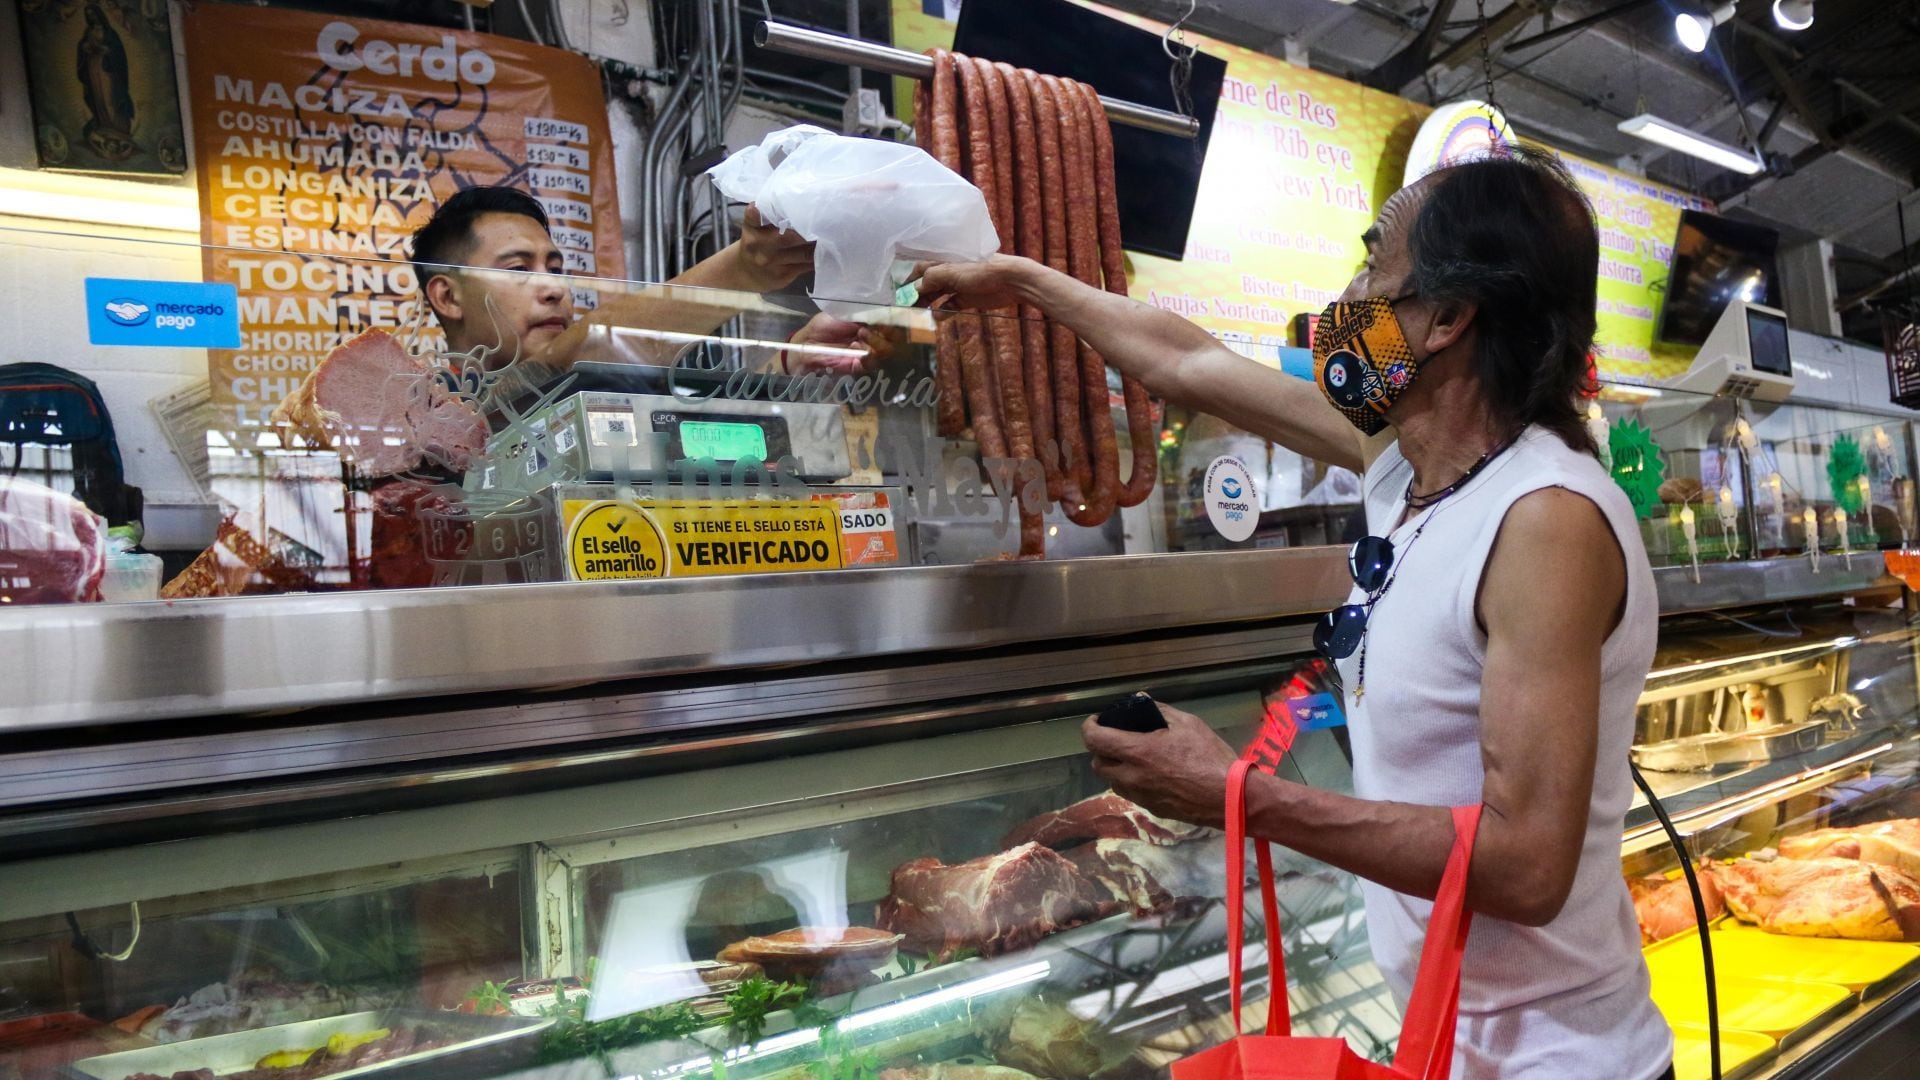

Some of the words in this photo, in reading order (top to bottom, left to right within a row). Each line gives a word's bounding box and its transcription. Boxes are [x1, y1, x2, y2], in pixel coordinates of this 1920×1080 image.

[317, 21, 496, 85] Cerdo
[214, 74, 413, 118] MACIZA
[1221, 75, 1257, 106] rne
[1265, 84, 1293, 117] de
[1299, 93, 1337, 128] Res
[217, 110, 342, 141] COSTILLA
[350, 123, 400, 146] CON
[408, 128, 479, 151] FALDA
[222, 136, 427, 172] AHUMADA
[1316, 141, 1352, 171] eye
[221, 165, 436, 203] LONGANIZA
[1268, 169, 1314, 199] New
[1320, 176, 1369, 213] York
[224, 194, 400, 227] CECINA
[1616, 199, 1653, 228] Cerdo
[1296, 232, 1313, 251] de
[1651, 237, 1673, 268] Esp
[228, 260, 419, 295] TOCINO
[1599, 256, 1643, 285] istorra
[155, 303, 224, 316] mercado
[155, 315, 196, 330] pago
[1320, 306, 1375, 357] Steelers
[233, 355, 323, 372] CHORI
[668, 339, 943, 407] Carnicería
[1390, 369, 1407, 385] NFL
[652, 414, 677, 422] L-PCR
[1218, 501, 1249, 511] mercado
[1225, 511, 1243, 521] pago
[674, 521, 690, 533] SI
[694, 521, 733, 533] TIENE
[736, 521, 750, 532] EL
[754, 520, 791, 533] SELLO
[794, 518, 826, 531] ESTÁ
[840, 513, 887, 529] ISADO
[582, 536, 599, 554] El
[601, 535, 641, 554] sello
[676, 539, 830, 567] VERIFICADO
[585, 554, 657, 573] amarillo
